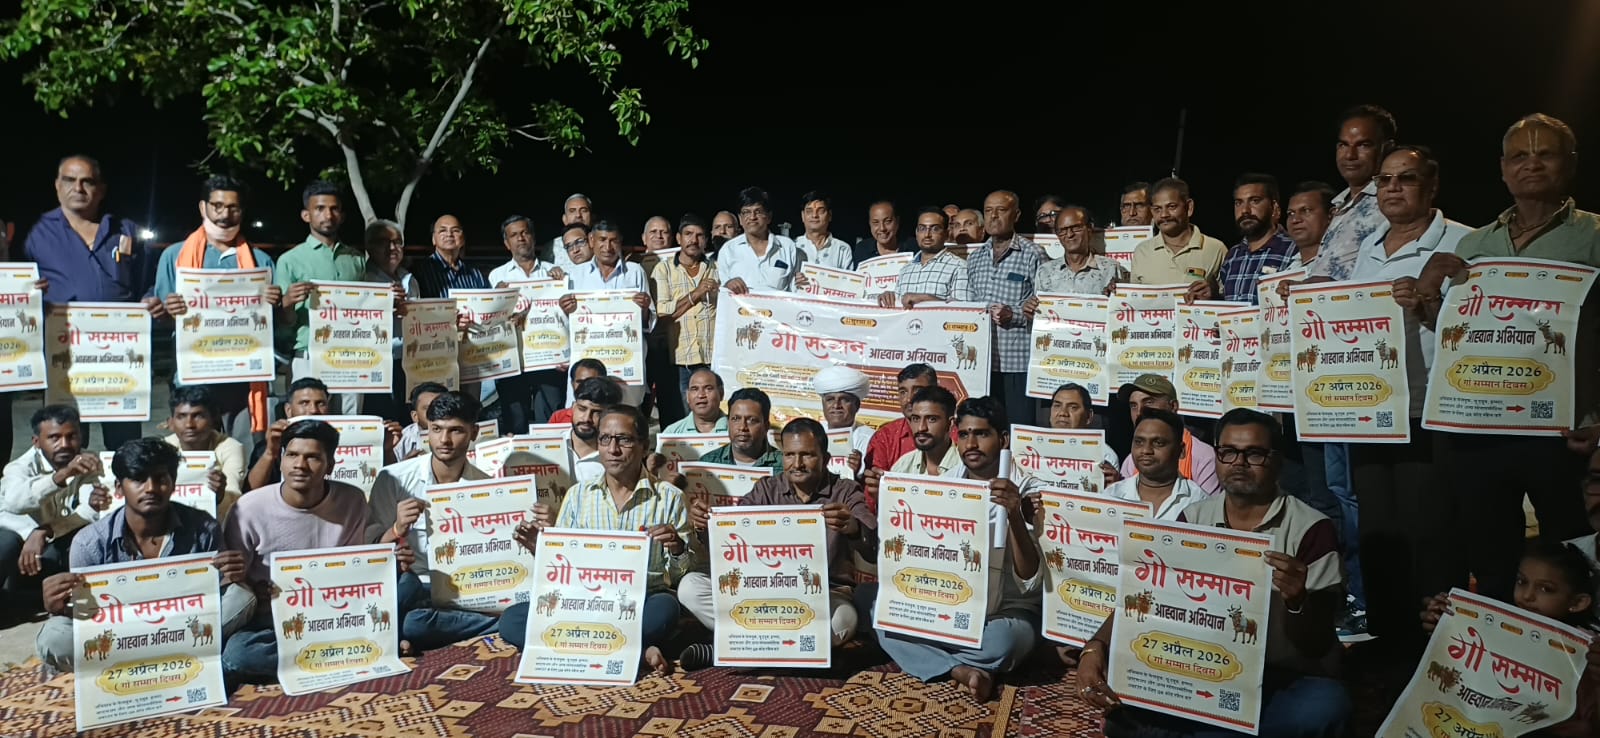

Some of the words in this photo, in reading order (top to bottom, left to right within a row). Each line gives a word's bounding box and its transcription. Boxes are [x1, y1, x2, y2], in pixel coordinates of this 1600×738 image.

[216, 295, 261, 313] सम्मान
[1488, 295, 1565, 320] सम्मान
[342, 308, 384, 325] सम्मान
[424, 323, 451, 338] सम्मान
[1328, 317, 1392, 343] सम्मान
[88, 332, 139, 349] सम्मान
[1455, 364, 1468, 374] 27
[1507, 366, 1541, 377] 2026
[1314, 382, 1326, 391] 27
[1356, 382, 1382, 390] 2026
[1474, 379, 1500, 388] सम्मान
[510, 463, 560, 476] सम्मान
[1046, 456, 1095, 476] सम्मान
[468, 510, 526, 535] सम्मान
[917, 513, 977, 540] सम्मान
[752, 544, 815, 568] सम्मान
[454, 573, 466, 581] 27
[496, 567, 519, 575] 2026
[576, 567, 635, 592] सम्मान
[900, 573, 911, 582] 27
[940, 579, 963, 590] 2026
[919, 588, 937, 597] सम्मान
[1066, 583, 1077, 593] 27
[1172, 568, 1256, 602] सम्मान
[319, 582, 384, 609] सम्मान
[130, 594, 206, 624] सम्मान
[739, 606, 750, 614] 27
[781, 606, 805, 614] 2026
[551, 628, 562, 636] 27
[593, 630, 617, 639] 2026
[305, 650, 315, 659] 27
[348, 645, 372, 654] 2026
[1142, 637, 1157, 649] 27
[1198, 650, 1230, 665] 2026
[107, 670, 122, 679] 27
[162, 660, 192, 671] 2026
[1164, 657, 1191, 671] सम्मान
[133, 678, 158, 687] सम्मान
[1489, 652, 1563, 700] सम्मान
[1434, 707, 1452, 722] 27
